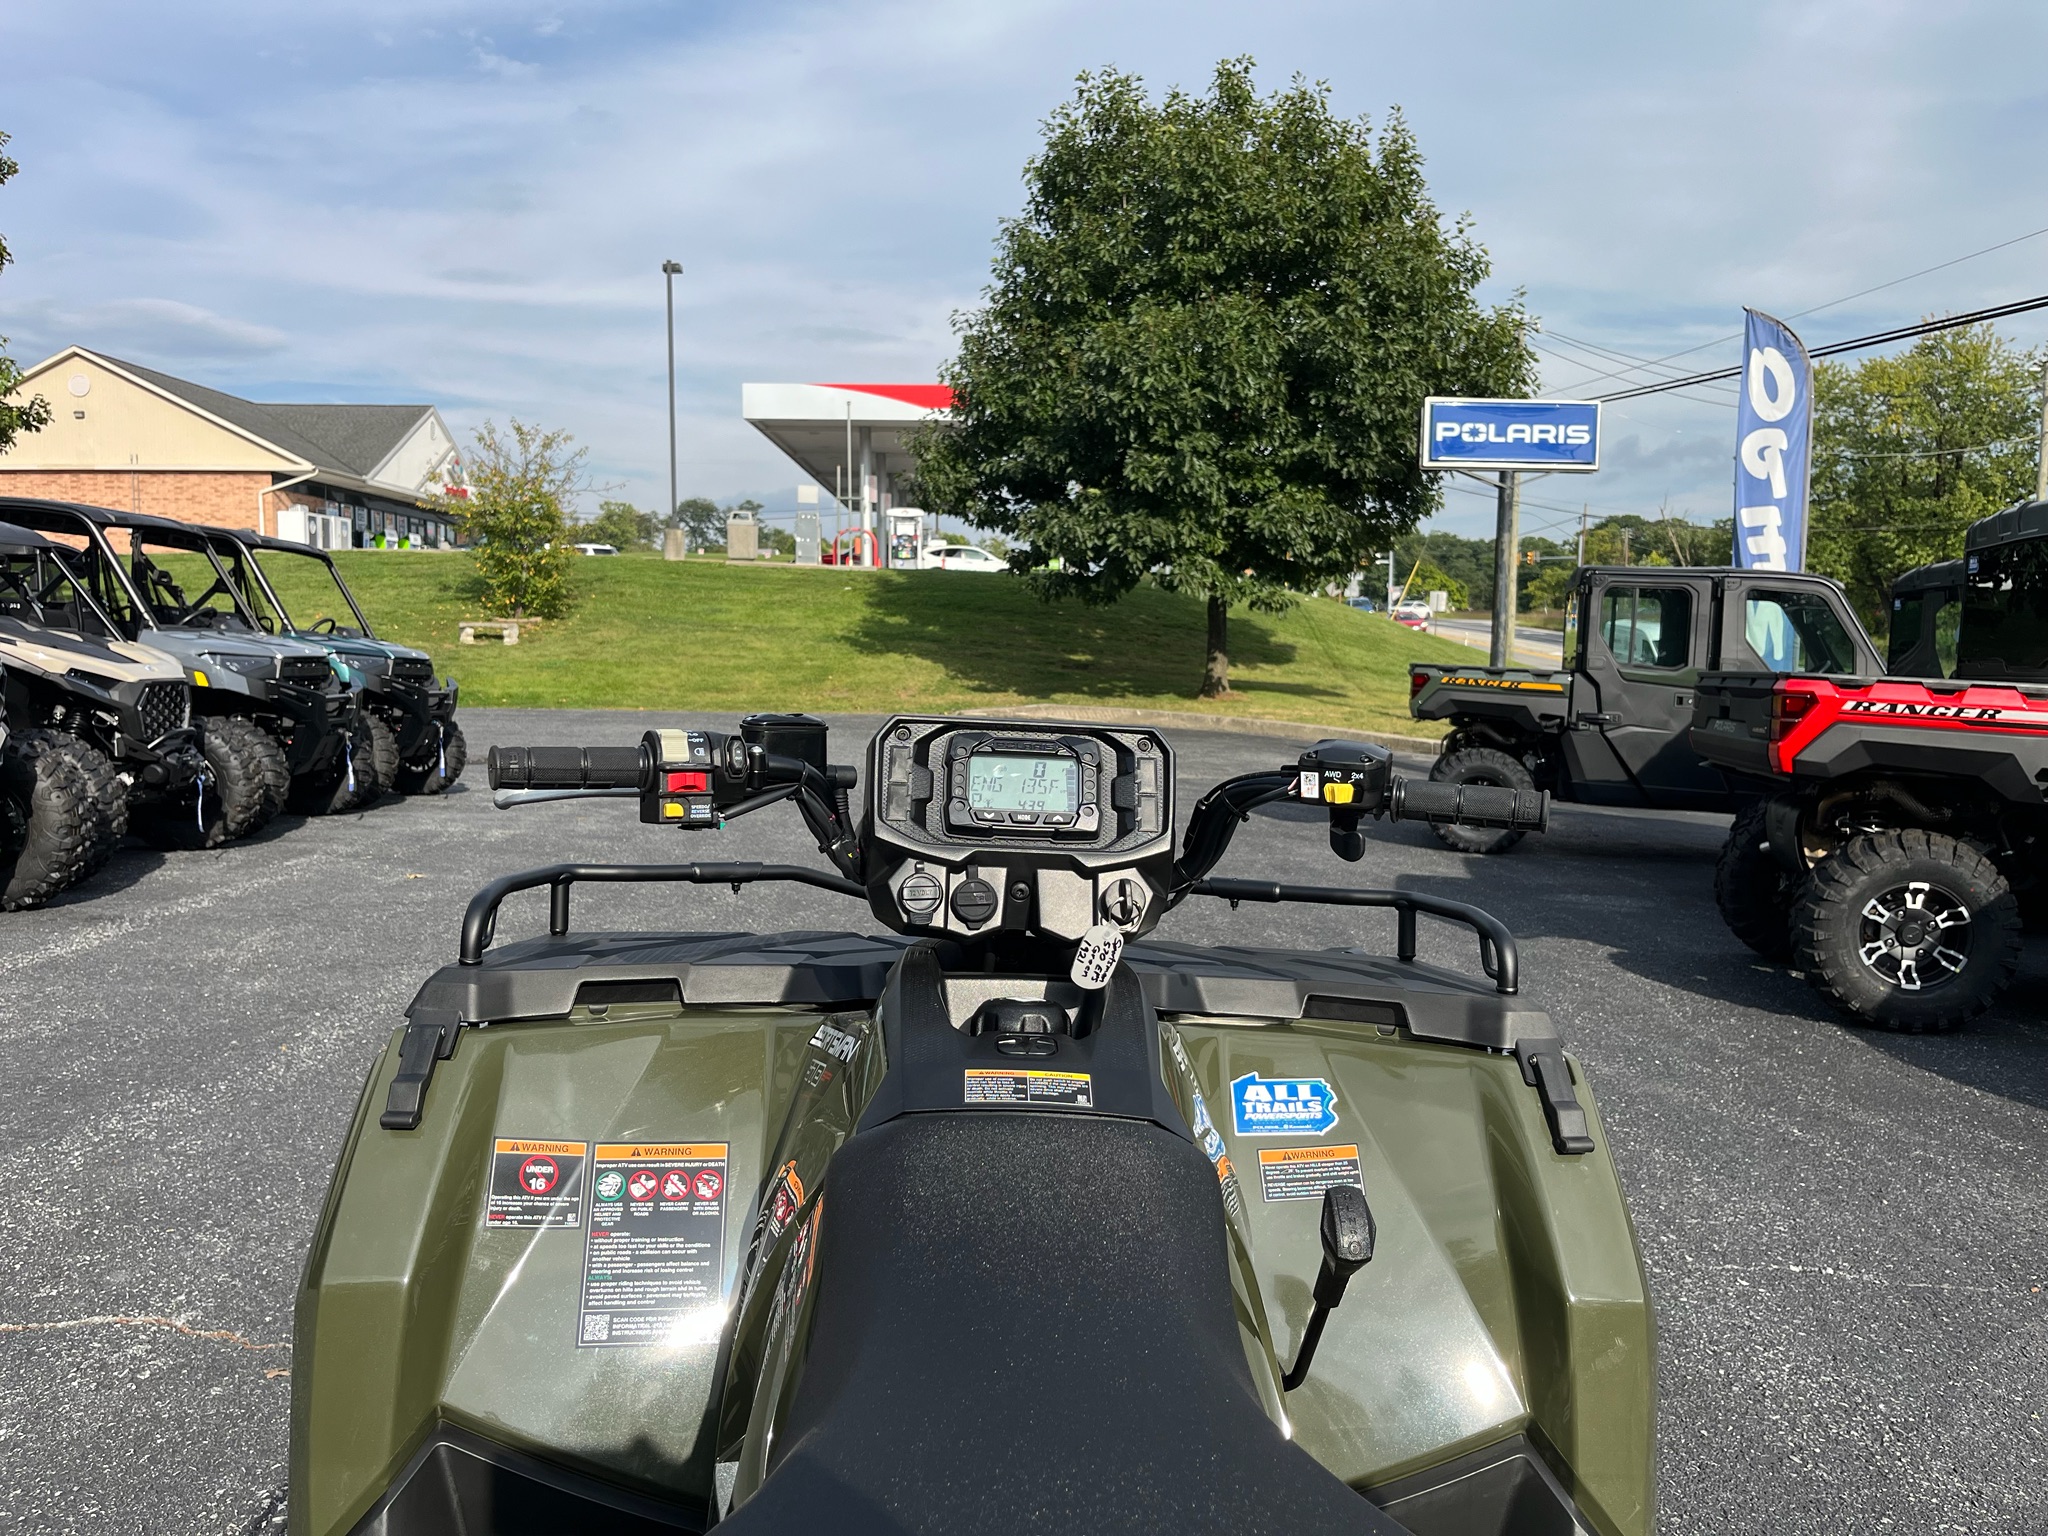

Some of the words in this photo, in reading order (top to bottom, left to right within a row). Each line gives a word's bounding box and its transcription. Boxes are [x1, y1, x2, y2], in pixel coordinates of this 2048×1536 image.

[1435, 422, 1591, 445] POLARIS
[1850, 701, 2002, 719] RANGER
[971, 776, 1002, 792] ENG
[1077, 940, 1091, 963] 1921
[1100, 941, 1110, 961] 570
[1082, 945, 1100, 977] Green
[1244, 1085, 1321, 1102] ALL
[1242, 1101, 1322, 1113] TRAILS
[522, 1144, 568, 1152] WARNING
[1292, 1150, 1335, 1159] WARNING
[529, 1178, 546, 1190] 16
